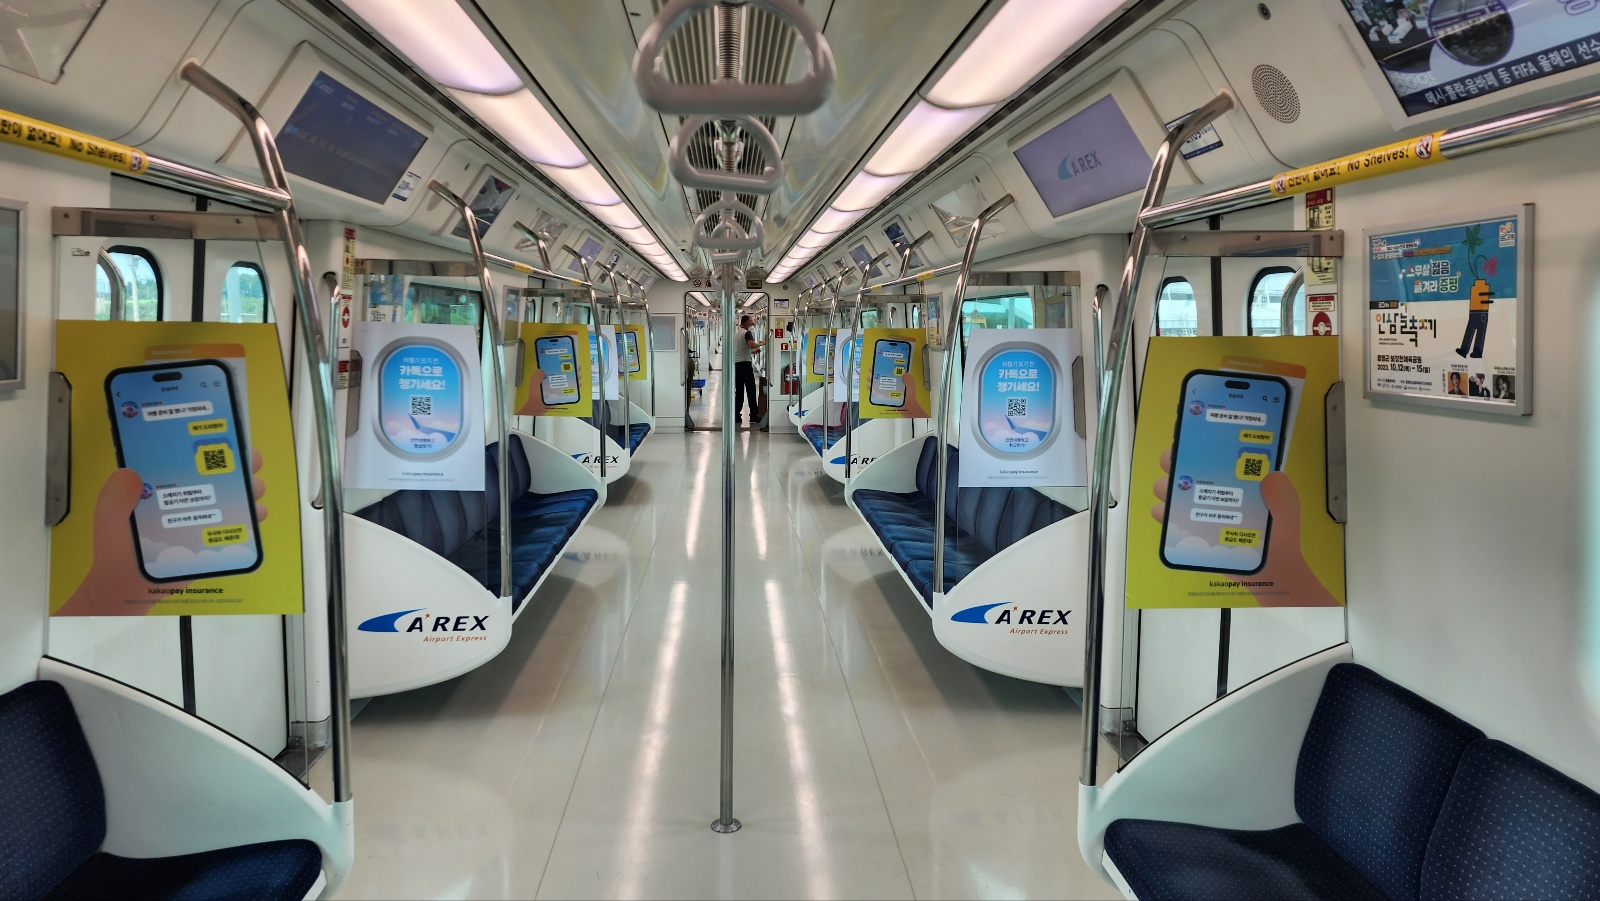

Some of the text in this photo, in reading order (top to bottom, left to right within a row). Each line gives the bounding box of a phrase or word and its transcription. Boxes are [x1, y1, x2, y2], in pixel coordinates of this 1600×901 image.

[1499, 68, 1512, 84] 등
[1511, 61, 1539, 79] FIFA
[1537, 46, 1577, 73] 올해의
[68, 138, 84, 152] No
[1071, 150, 1102, 176] AREX
[1347, 158, 1360, 172] No
[1364, 142, 1411, 168] Shelves!
[1407, 264, 1430, 277] 스무살
[1440, 277, 1458, 292] 증평
[1209, 580, 1240, 588] kakaopay
[148, 588, 184, 596] kakaopay
[406, 615, 489, 632] AREX
[994, 609, 1072, 625] AREX
[455, 635, 487, 643] Express
[1009, 628, 1068, 636] Airport Express
